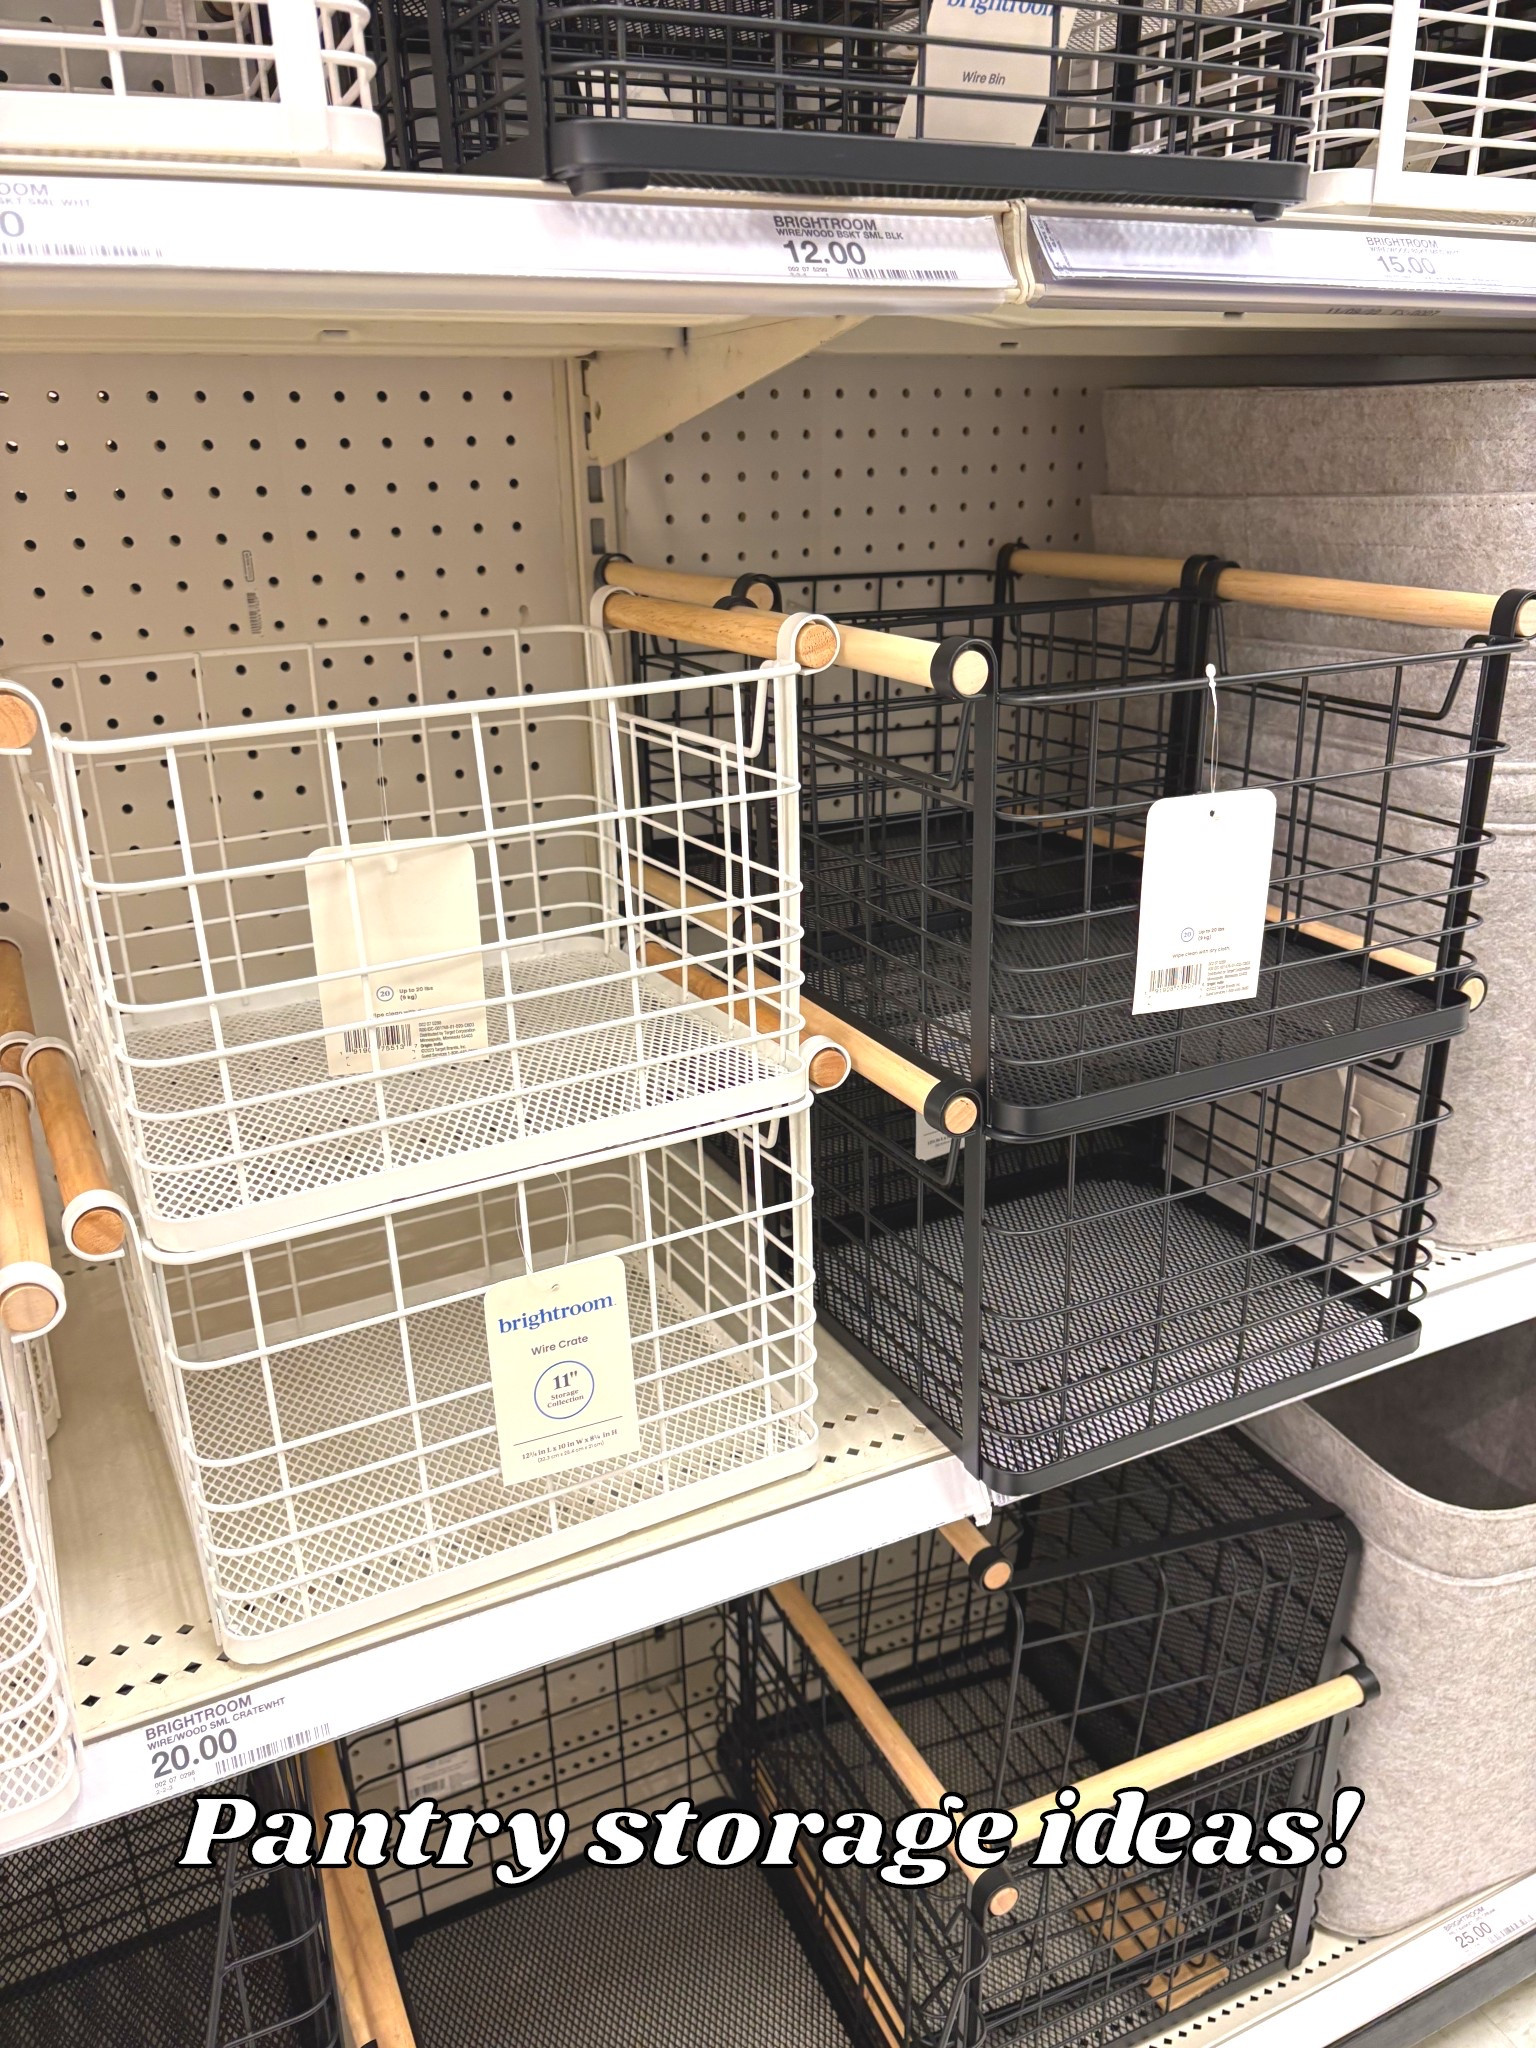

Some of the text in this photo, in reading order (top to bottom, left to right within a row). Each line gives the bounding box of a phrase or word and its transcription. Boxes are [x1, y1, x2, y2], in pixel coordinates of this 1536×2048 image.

[962, 71, 1006, 86] Wire Bin
[773, 215, 878, 231] BRIGHTROOM
[776, 228, 904, 241] WIRE/WOOD BSKT SML BLK
[1366, 236, 1439, 249] BRIGHTROOM
[783, 240, 867, 265] 12.00
[1377, 255, 1436, 275] 15.00
[379, 990, 391, 998] 20
[498, 1295, 614, 1334] brightroom
[531, 1335, 589, 1356] Wire Crate
[553, 1370, 578, 1390] 11"
[547, 1394, 584, 1408] Collection
[551, 1388, 579, 1402] Storage
[145, 1694, 252, 1741] BRIGHTROOM
[147, 1696, 286, 1751] WIRE/WOOD SML CRATEWHT
[151, 1728, 237, 1779] 20.00
[169, 1775, 177, 1784] 07
[1455, 1922, 1492, 1948] 25.00
